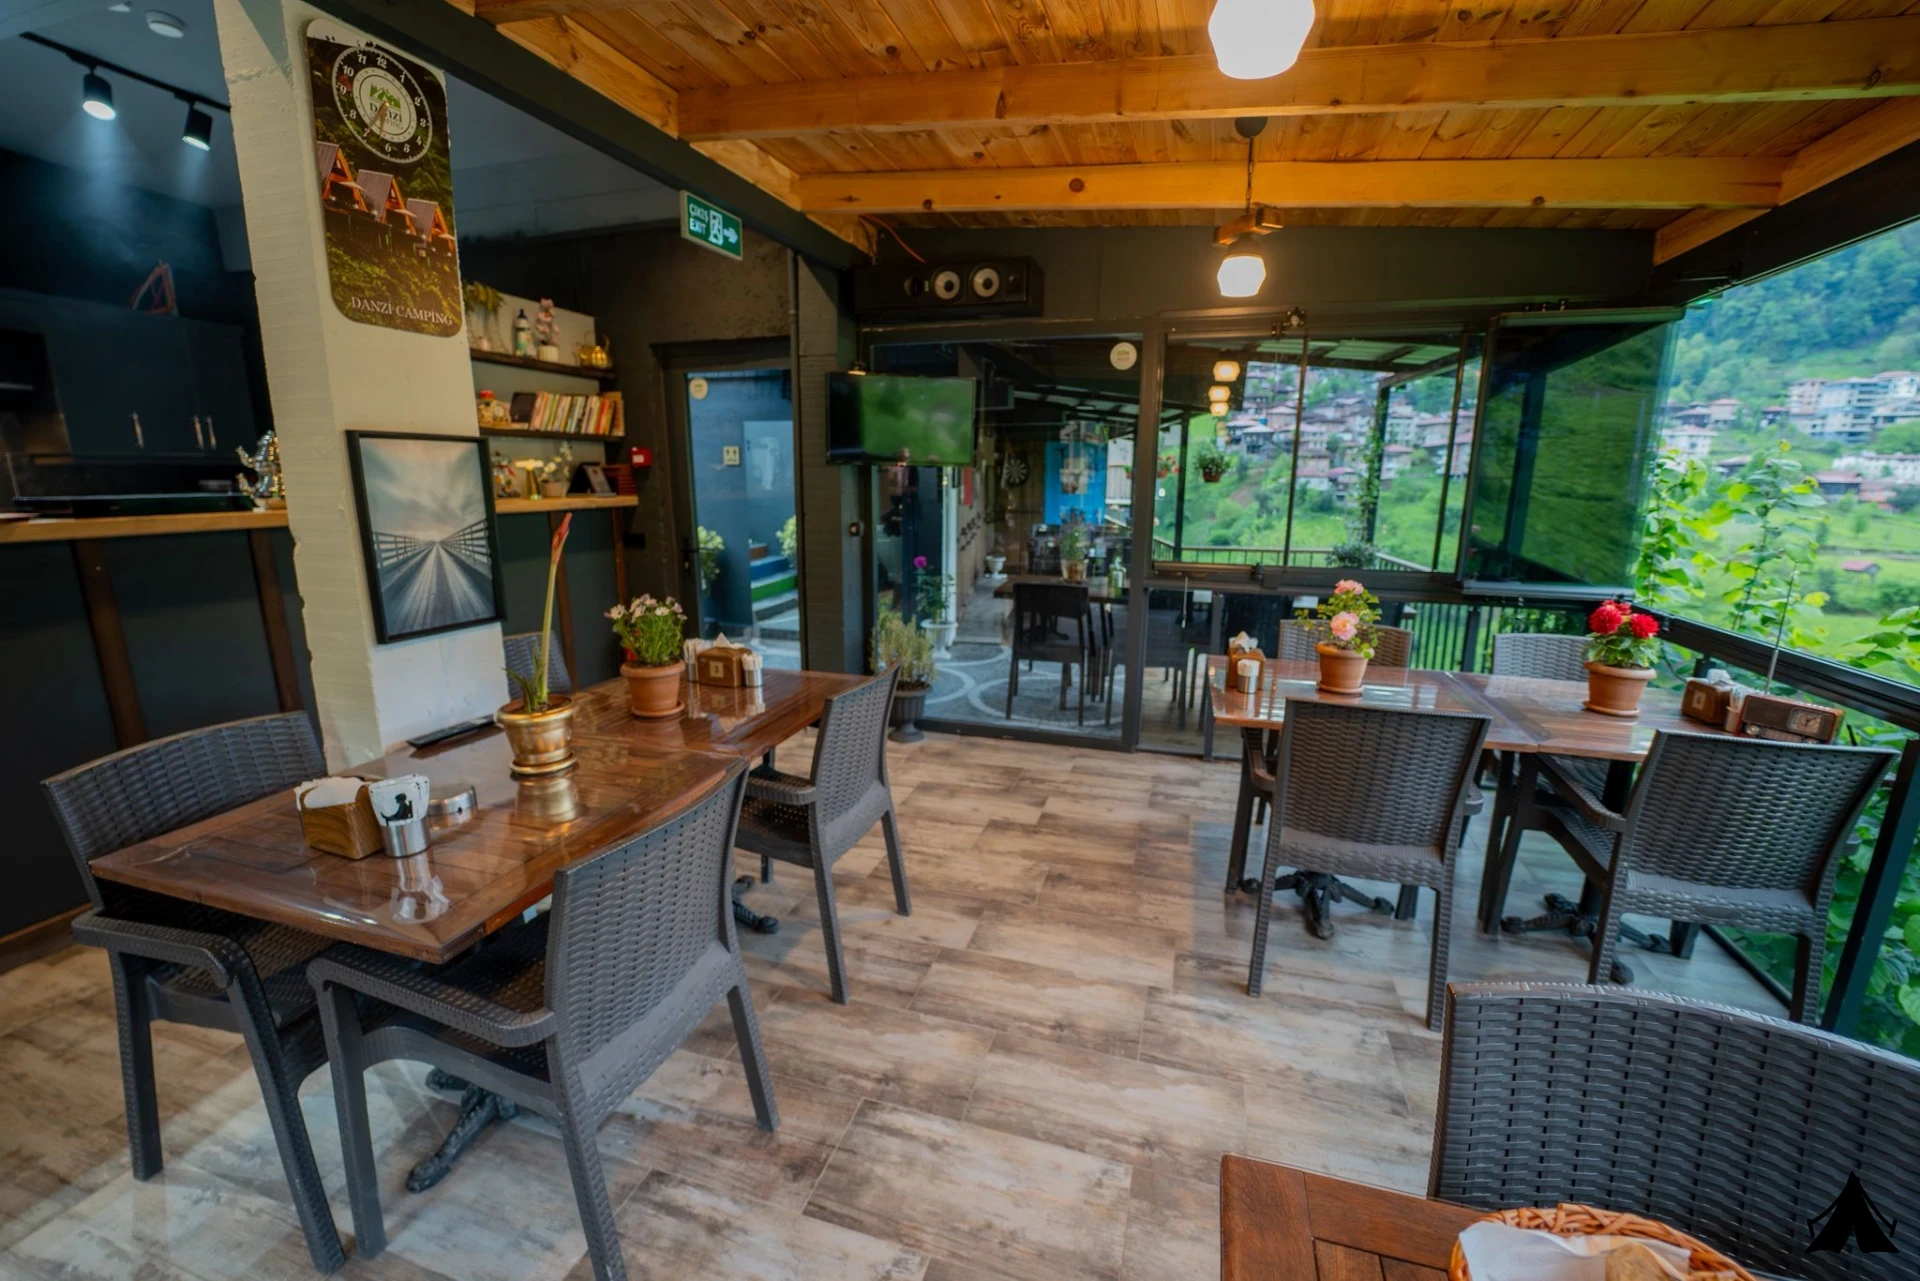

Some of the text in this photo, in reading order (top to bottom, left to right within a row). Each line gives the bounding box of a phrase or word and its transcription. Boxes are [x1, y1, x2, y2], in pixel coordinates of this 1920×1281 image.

[358, 54, 367, 65] 11
[376, 57, 387, 69] 12
[342, 65, 354, 77] 10
[400, 74, 405, 83] 1
[339, 84, 347, 95] 9
[414, 96, 421, 107] 2
[349, 110, 357, 119] 8
[385, 142, 391, 152] 6
[690, 218, 706, 235] EXIT
